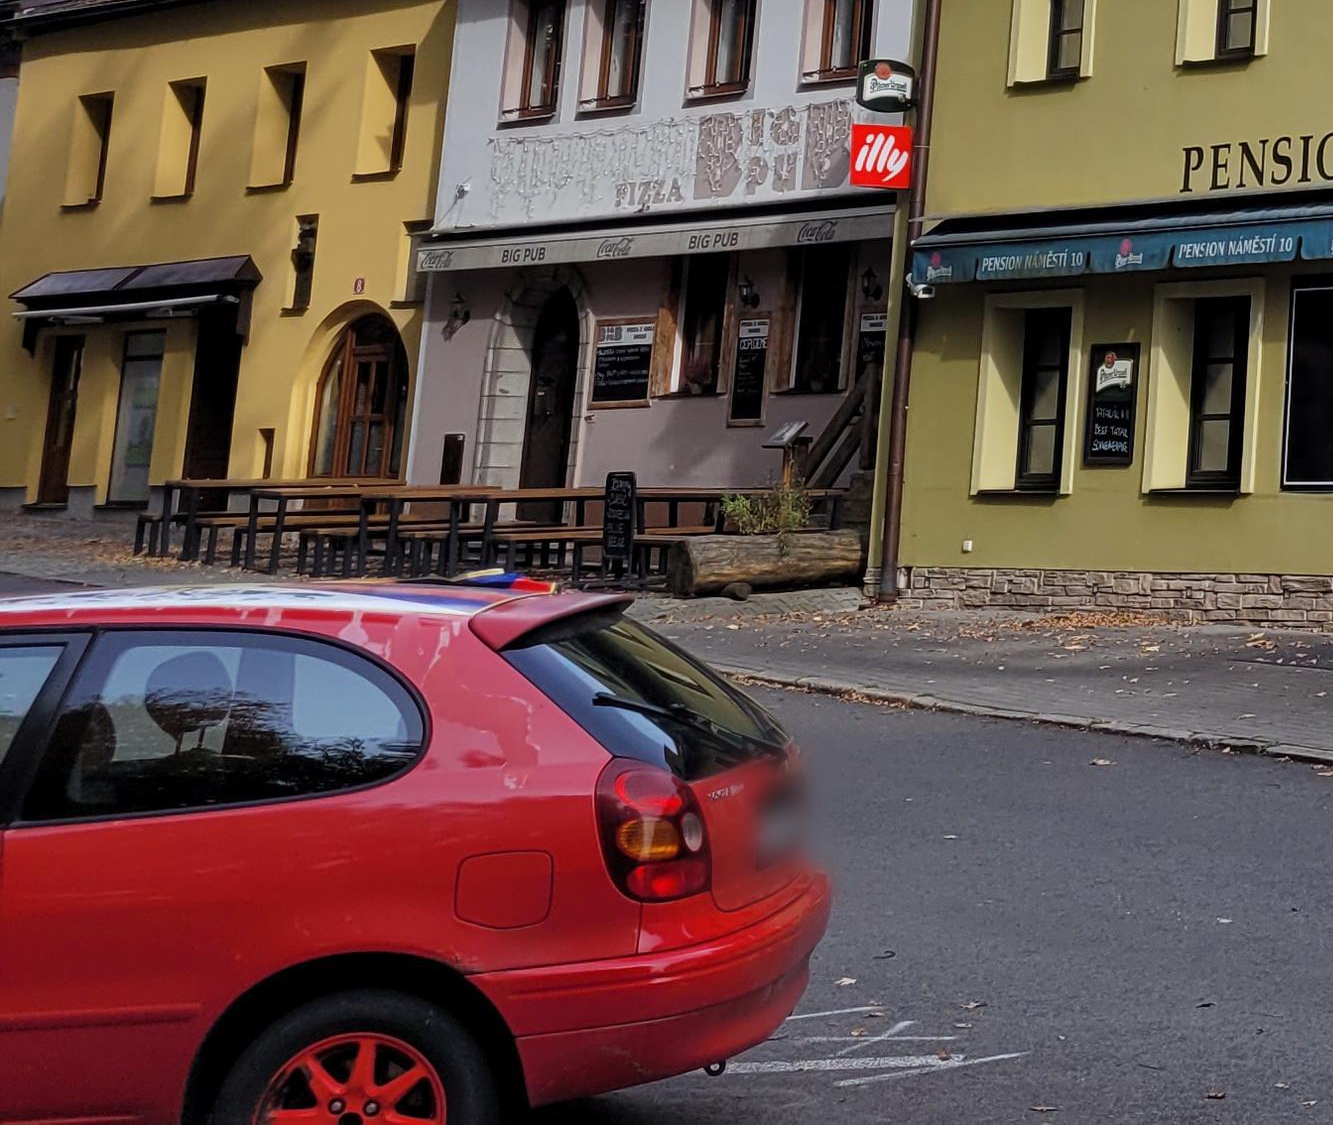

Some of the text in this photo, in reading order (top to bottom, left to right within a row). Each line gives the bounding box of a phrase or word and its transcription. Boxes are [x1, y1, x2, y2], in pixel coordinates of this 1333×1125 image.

[855, 133, 908, 182] illy
[614, 179, 683, 207] PIZZA
[688, 232, 738, 250] BIG PUB
[1179, 234, 1293, 259] PENSION NÁMĚSTÍ 10
[502, 247, 546, 263] BIG PUB
[982, 249, 1083, 272] PENSION NÁMĚSTÍ 10
